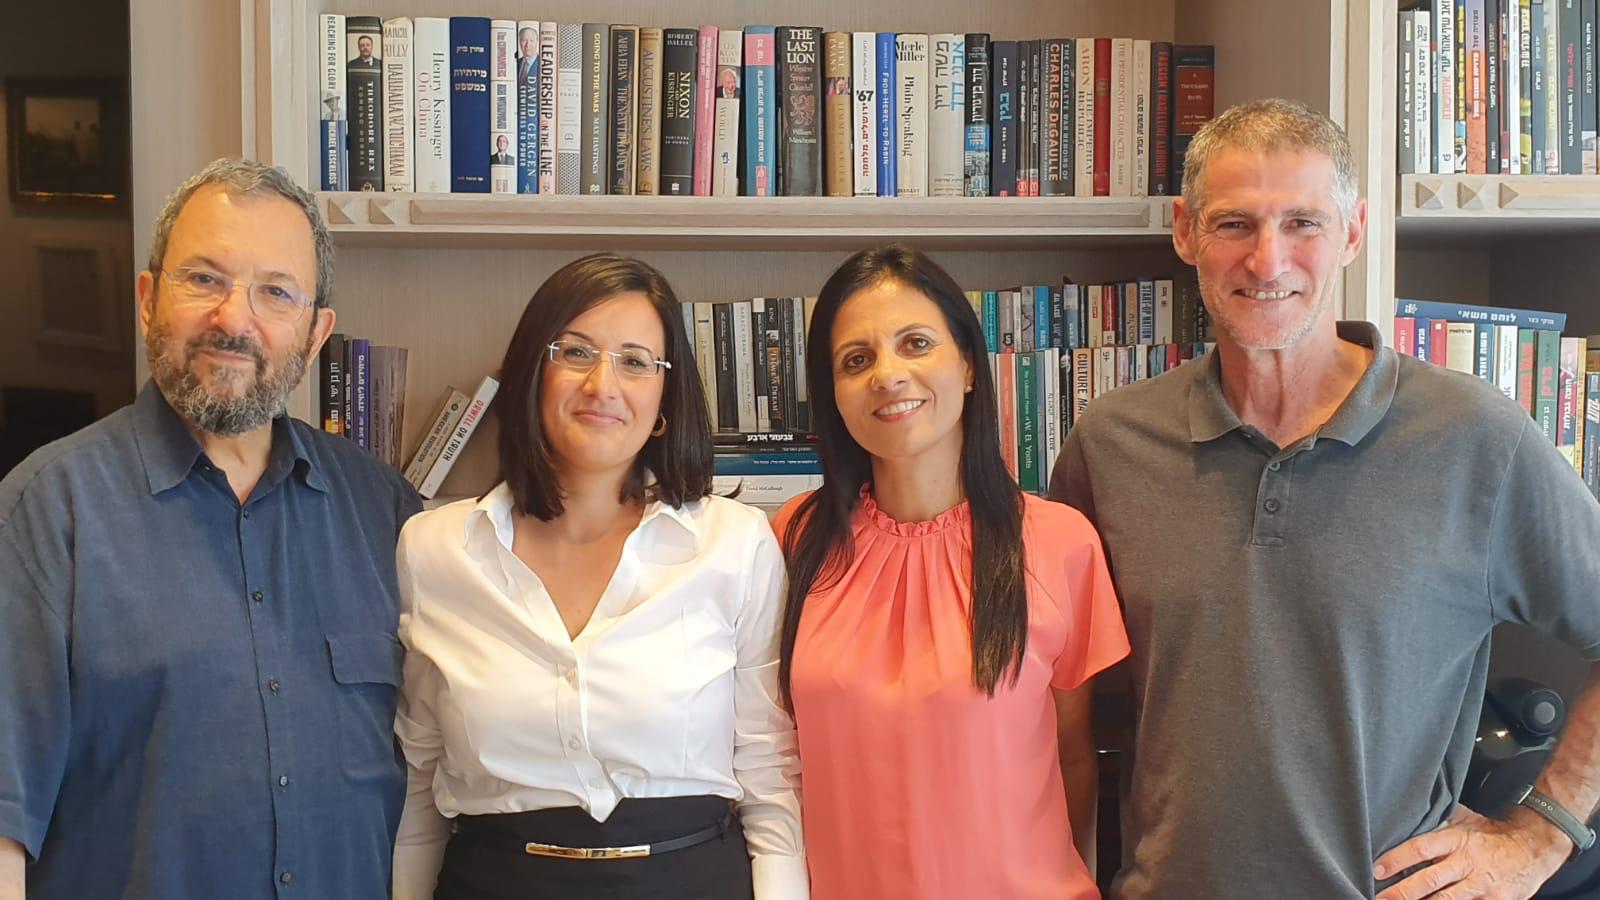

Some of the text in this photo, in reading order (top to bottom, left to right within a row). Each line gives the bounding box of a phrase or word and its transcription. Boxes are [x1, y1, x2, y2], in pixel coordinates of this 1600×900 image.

[617, 35, 628, 57] ABBA
[787, 41, 815, 52] LAST
[789, 29, 813, 40] THE
[1442, 34, 1452, 55] אהוד
[328, 16, 336, 90] REACHING FOR GLORY
[593, 61, 600, 72] TO
[787, 53, 815, 64] LION
[1082, 47, 1090, 86] ARON
[1442, 55, 1452, 73] יערי
[541, 44, 553, 119] LEADERSHIP
[617, 59, 628, 80] EBAN
[935, 41, 949, 110] משה דיין
[951, 41, 964, 112] אבני דרך
[972, 68, 984, 82] דוד
[1049, 43, 1060, 109] CHARLES
[1157, 51, 1168, 88] FASCISM
[455, 83, 486, 92] במשפט
[617, 88, 628, 105] THE
[667, 72, 675, 118] KISSINGER
[679, 72, 691, 119] NIXON
[856, 90, 874, 102] '67
[1117, 60, 1125, 112] PRESIDENTIAL
[418, 72, 430, 138] On China
[430, 52, 445, 160] Henry Kissinger
[641, 49, 654, 172] AUGUSTINE'S LAWS
[901, 76, 915, 157] Plain Speaking
[1000, 92, 1012, 121] בגין
[388, 63, 404, 176] BARBARA W. TUCHMAN
[528, 76, 537, 177] DAVID GERGEN
[541, 120, 548, 131] ON
[592, 117, 600, 135] MAX
[520, 131, 526, 141] TO
[541, 133, 549, 149] THE
[328, 121, 336, 185] MICHAEL BESCHLOSS
[540, 150, 553, 176] LINE
[592, 137, 600, 174] HASTINGS
[1062, 170, 1069, 180] OF
[1141, 284, 1152, 339] START-UP NATION
[1490, 313, 1517, 323] לוחם
[1078, 353, 1089, 394] CULTURE
[770, 385, 778, 411] DREAM
[442, 400, 484, 462] ORWELL ON TRUTH
[1024, 421, 1032, 431] W.
[1025, 434, 1032, 443] B.
